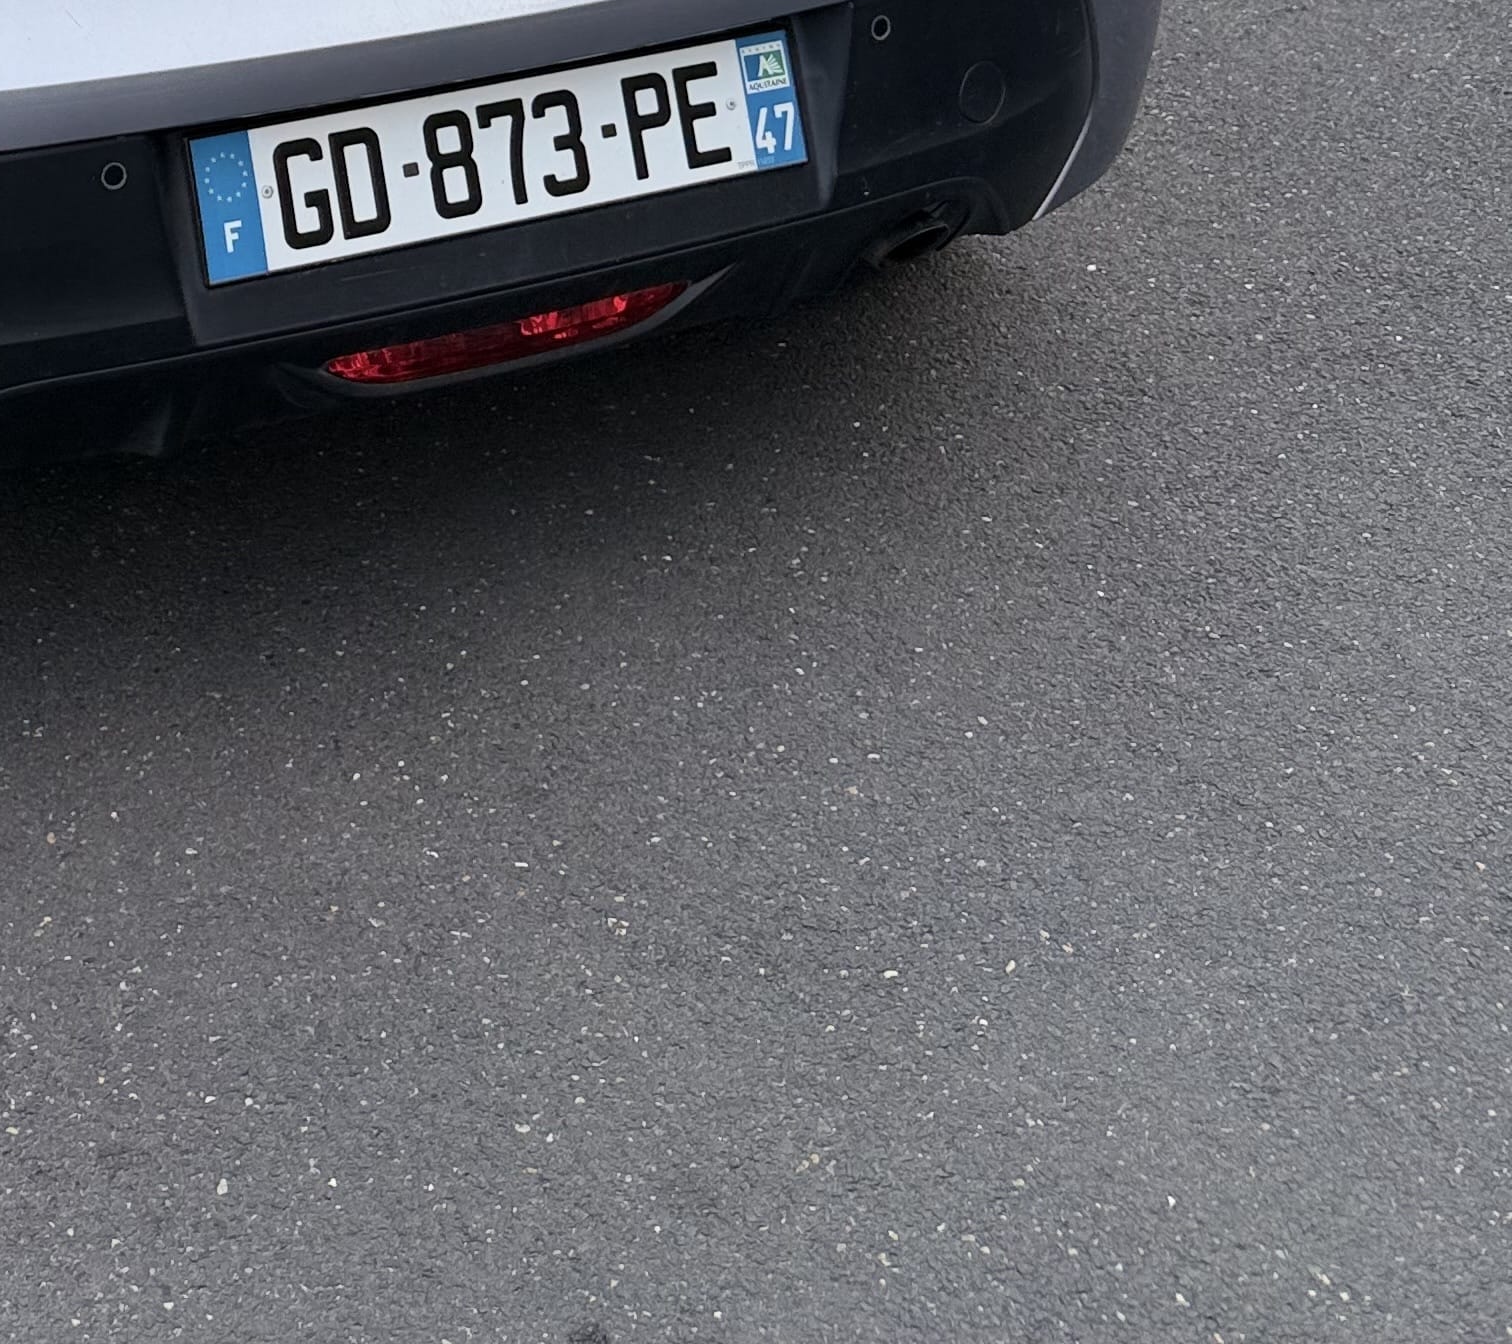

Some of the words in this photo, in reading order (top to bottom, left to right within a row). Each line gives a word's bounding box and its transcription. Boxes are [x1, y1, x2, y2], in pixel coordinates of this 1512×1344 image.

[748, 77, 788, 92] AQUITAINE
[755, 101, 795, 155] 47
[273, 61, 732, 250] GD-873-PE
[223, 219, 243, 253] F
